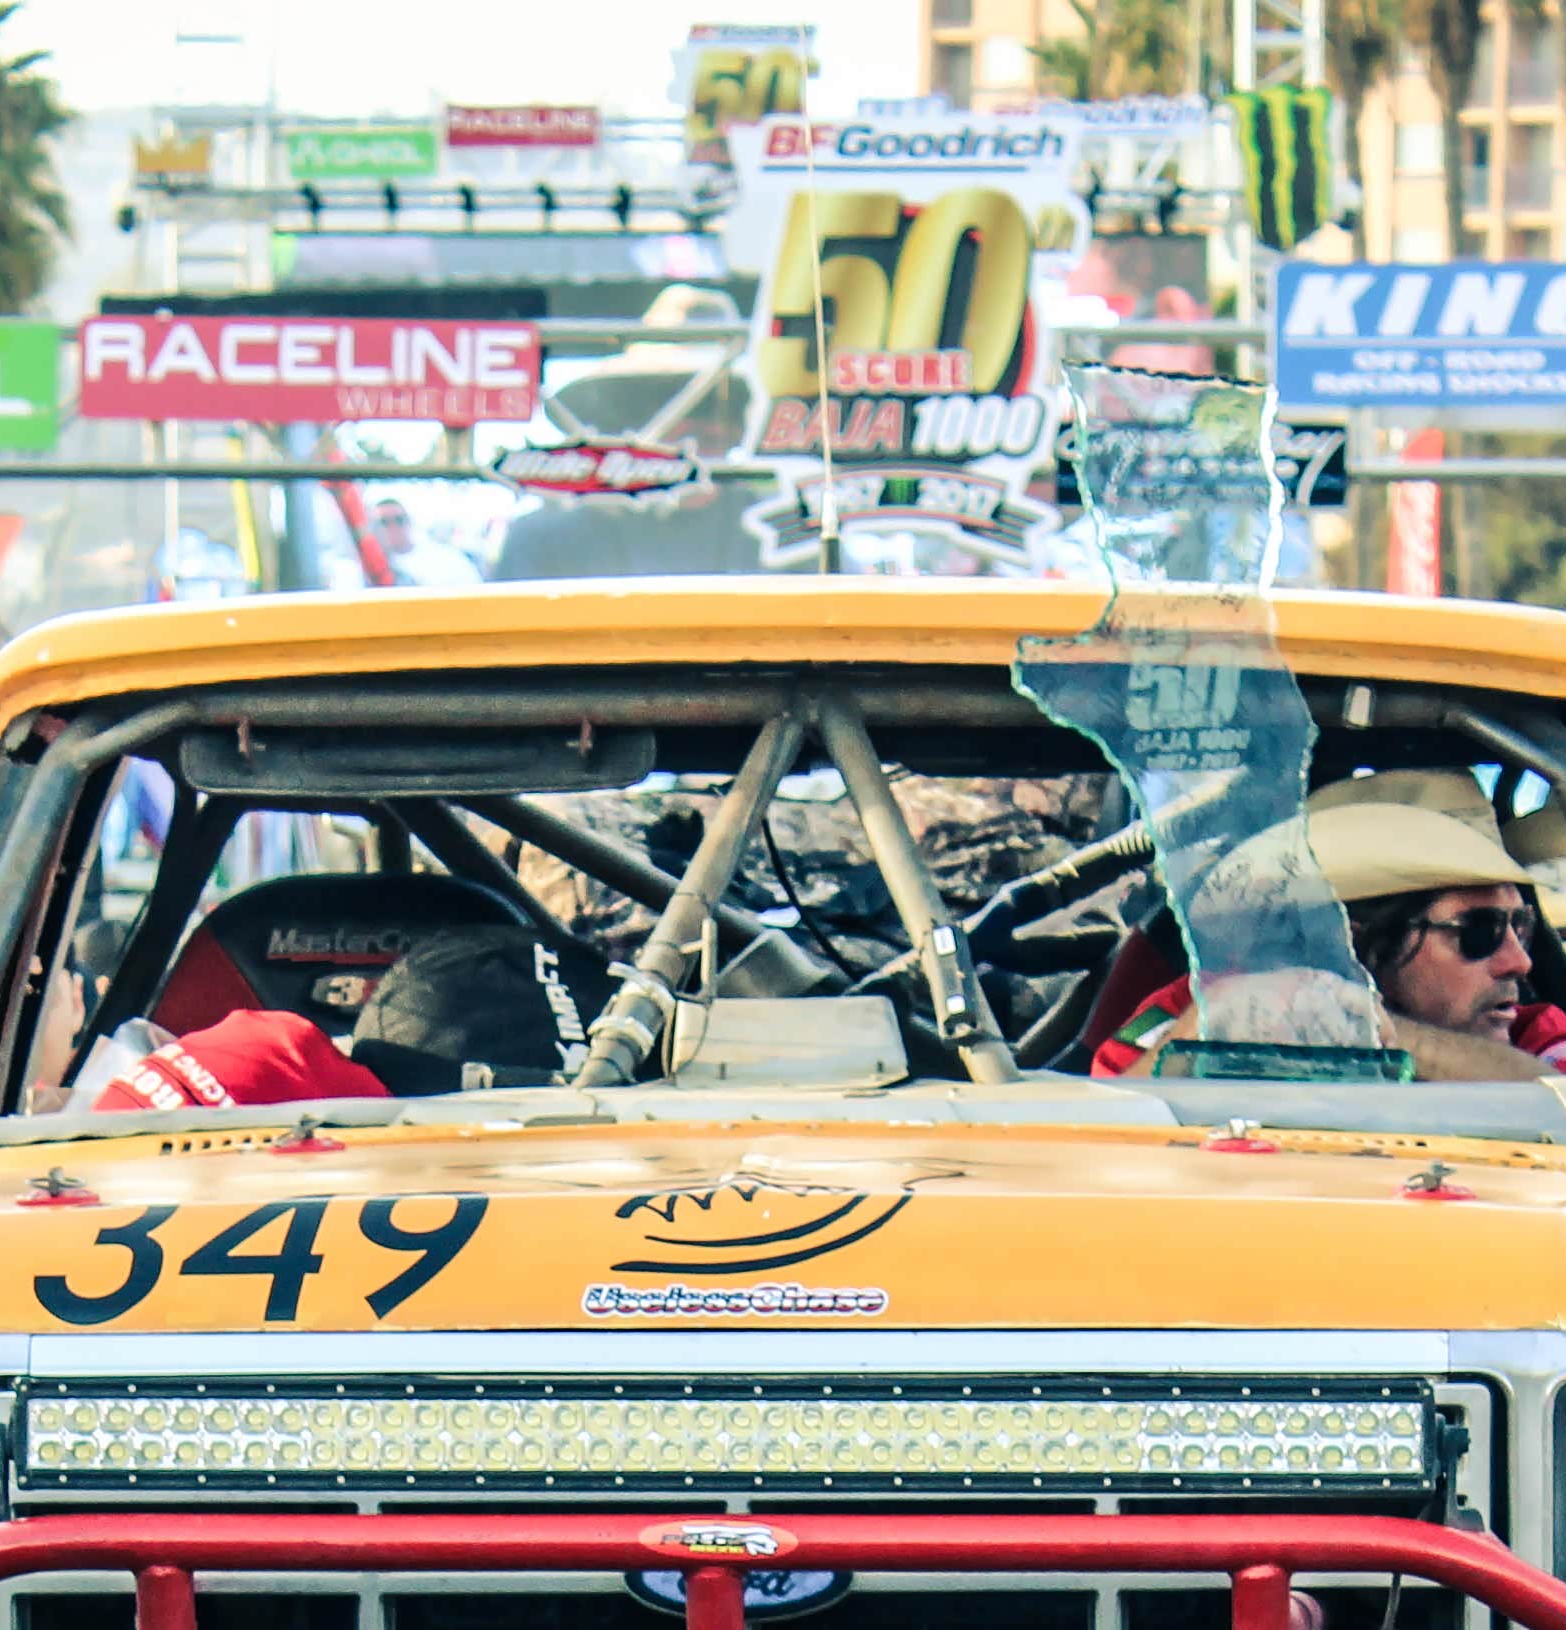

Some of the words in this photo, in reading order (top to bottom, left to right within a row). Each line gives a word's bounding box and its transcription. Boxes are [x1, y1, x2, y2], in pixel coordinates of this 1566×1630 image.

[765, 122, 1065, 158] BFGoodrich
[84, 322, 532, 386] RACELINE
[835, 353, 971, 389] SCORE
[335, 387, 531, 418] WHEELS
[759, 399, 906, 451] BAJA
[910, 395, 1043, 455] 1000
[32, 1192, 490, 1326] 349
